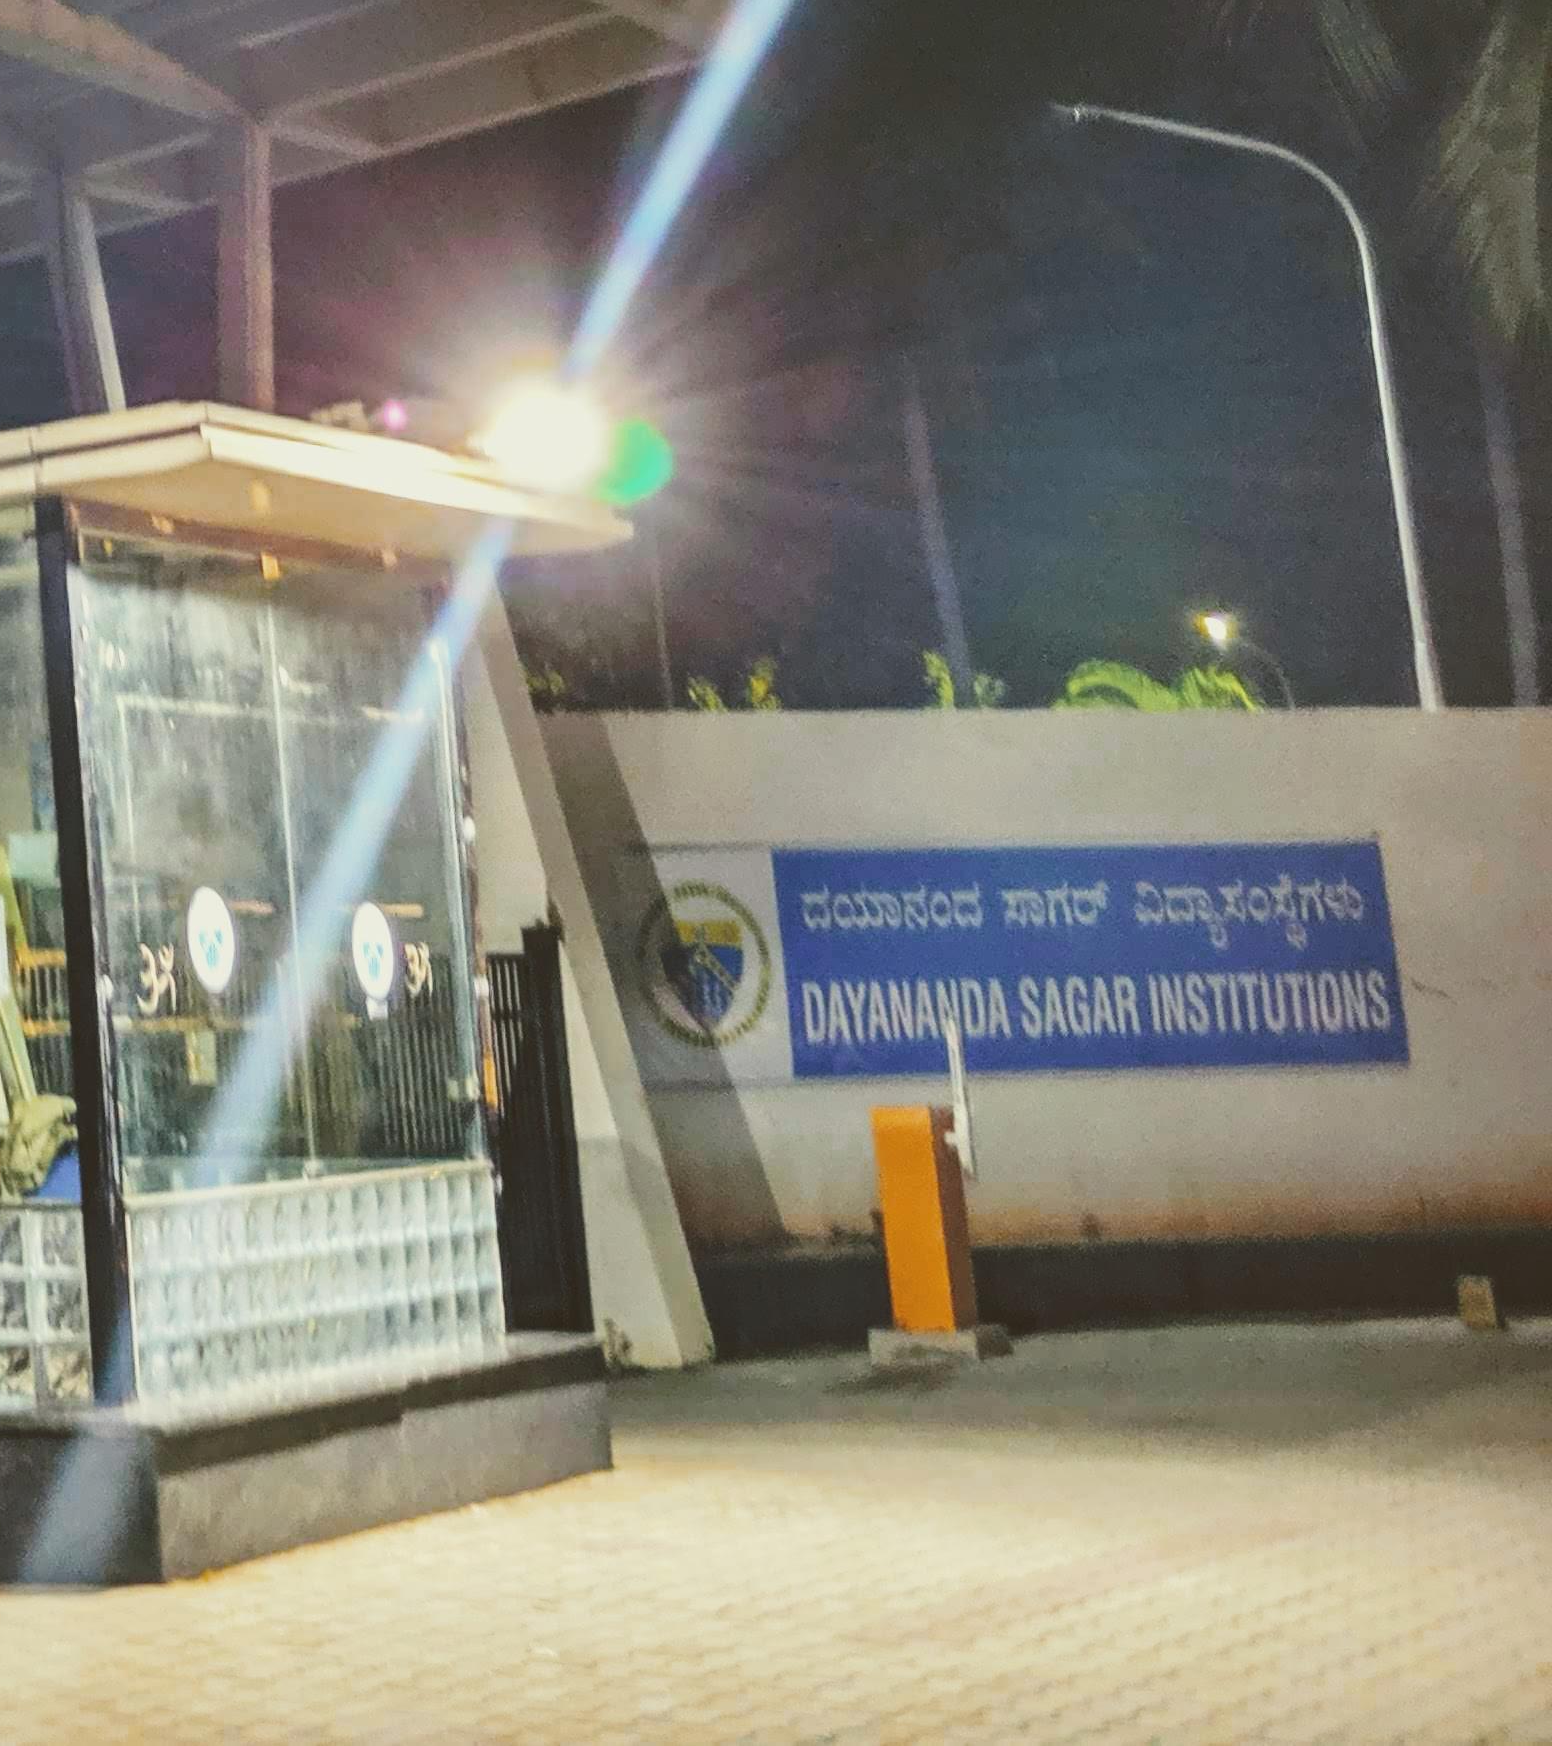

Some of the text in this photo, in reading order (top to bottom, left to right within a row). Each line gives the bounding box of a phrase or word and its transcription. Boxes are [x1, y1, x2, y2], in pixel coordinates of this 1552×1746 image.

[800, 882, 984, 930] ದಯಾನಂದ
[1001, 879, 1109, 928] ಸಾಗರ್
[801, 967, 1391, 1046] DAYANANDA SAGAR INSTITUTIONS
